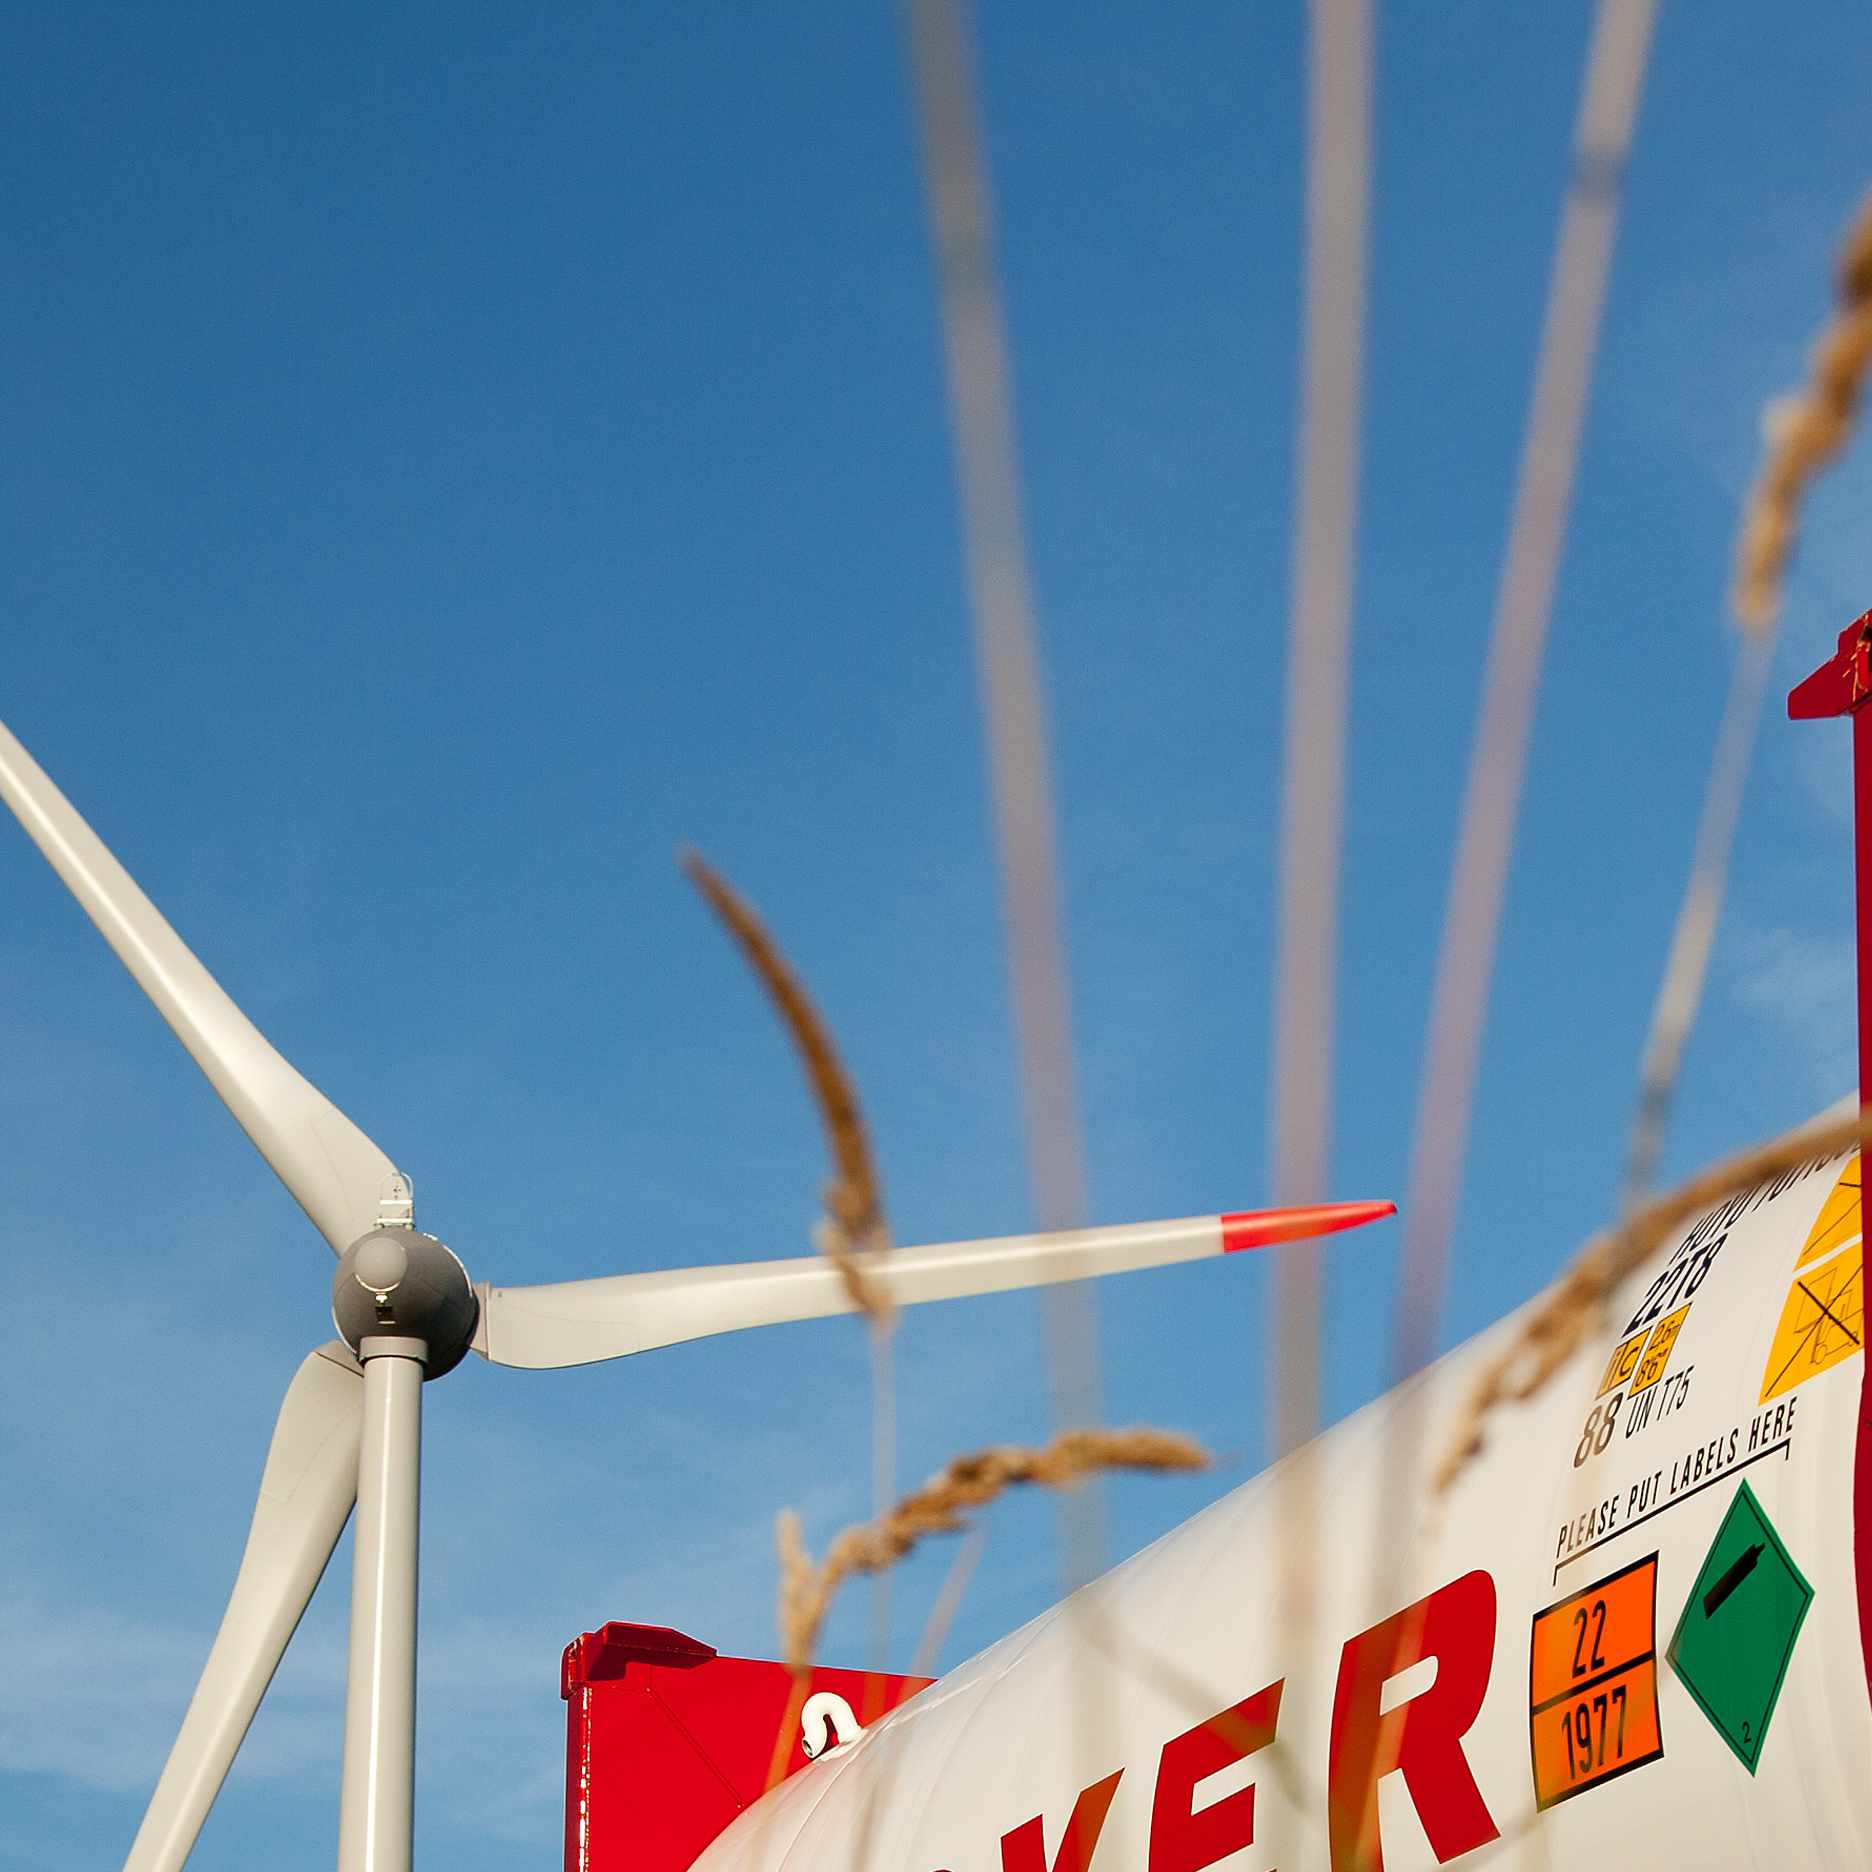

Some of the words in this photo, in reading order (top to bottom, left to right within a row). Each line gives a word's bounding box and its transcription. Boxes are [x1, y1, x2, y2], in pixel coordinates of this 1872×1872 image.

[1623, 1233, 1728, 1338] 22T8
[1574, 1392, 1624, 1468] 88
[1626, 1386, 1658, 1439] UN
[1657, 1365, 1695, 1421] T75
[1556, 1500, 1619, 1558] PLEASE
[1627, 1471, 1662, 1519] PUT
[1670, 1430, 1739, 1495] LABELS
[1747, 1396, 1797, 1452] HERE
[1572, 1599, 1607, 1679] 22
[1561, 1685, 1628, 1780] 1977
